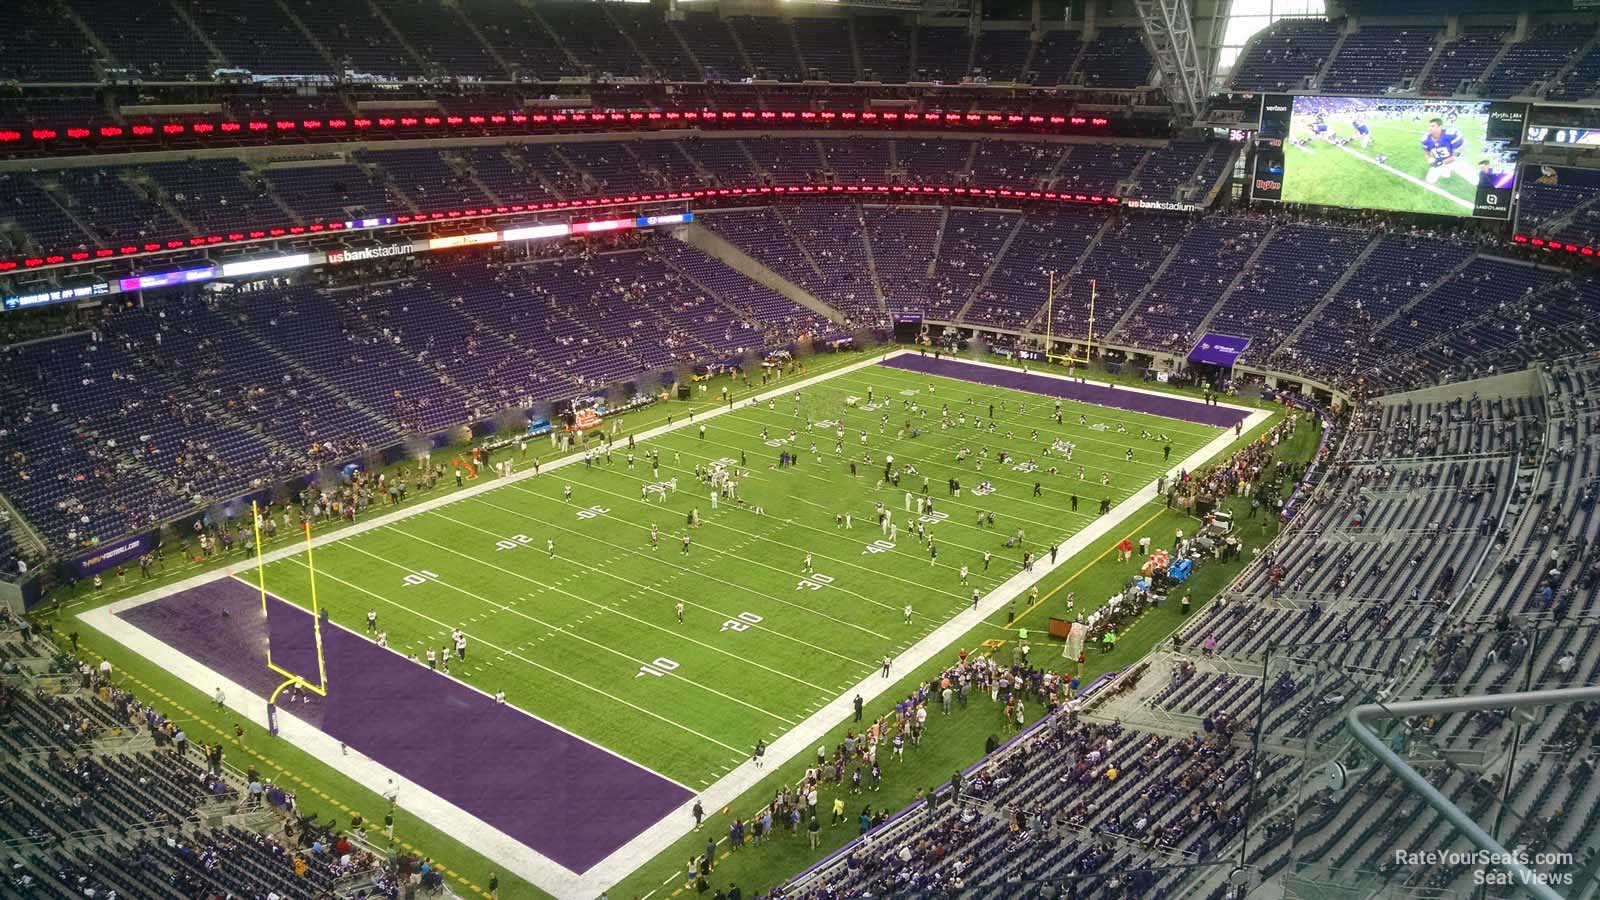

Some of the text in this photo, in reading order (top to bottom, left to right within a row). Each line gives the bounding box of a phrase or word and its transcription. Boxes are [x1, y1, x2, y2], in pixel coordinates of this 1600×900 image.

[577, 505, 611, 519] 30
[496, 533, 534, 550] 20
[864, 539, 897, 554] 40
[403, 569, 440, 585] 10
[797, 573, 835, 591] 30
[721, 611, 764, 632] 20
[639, 656, 681, 677] 10
